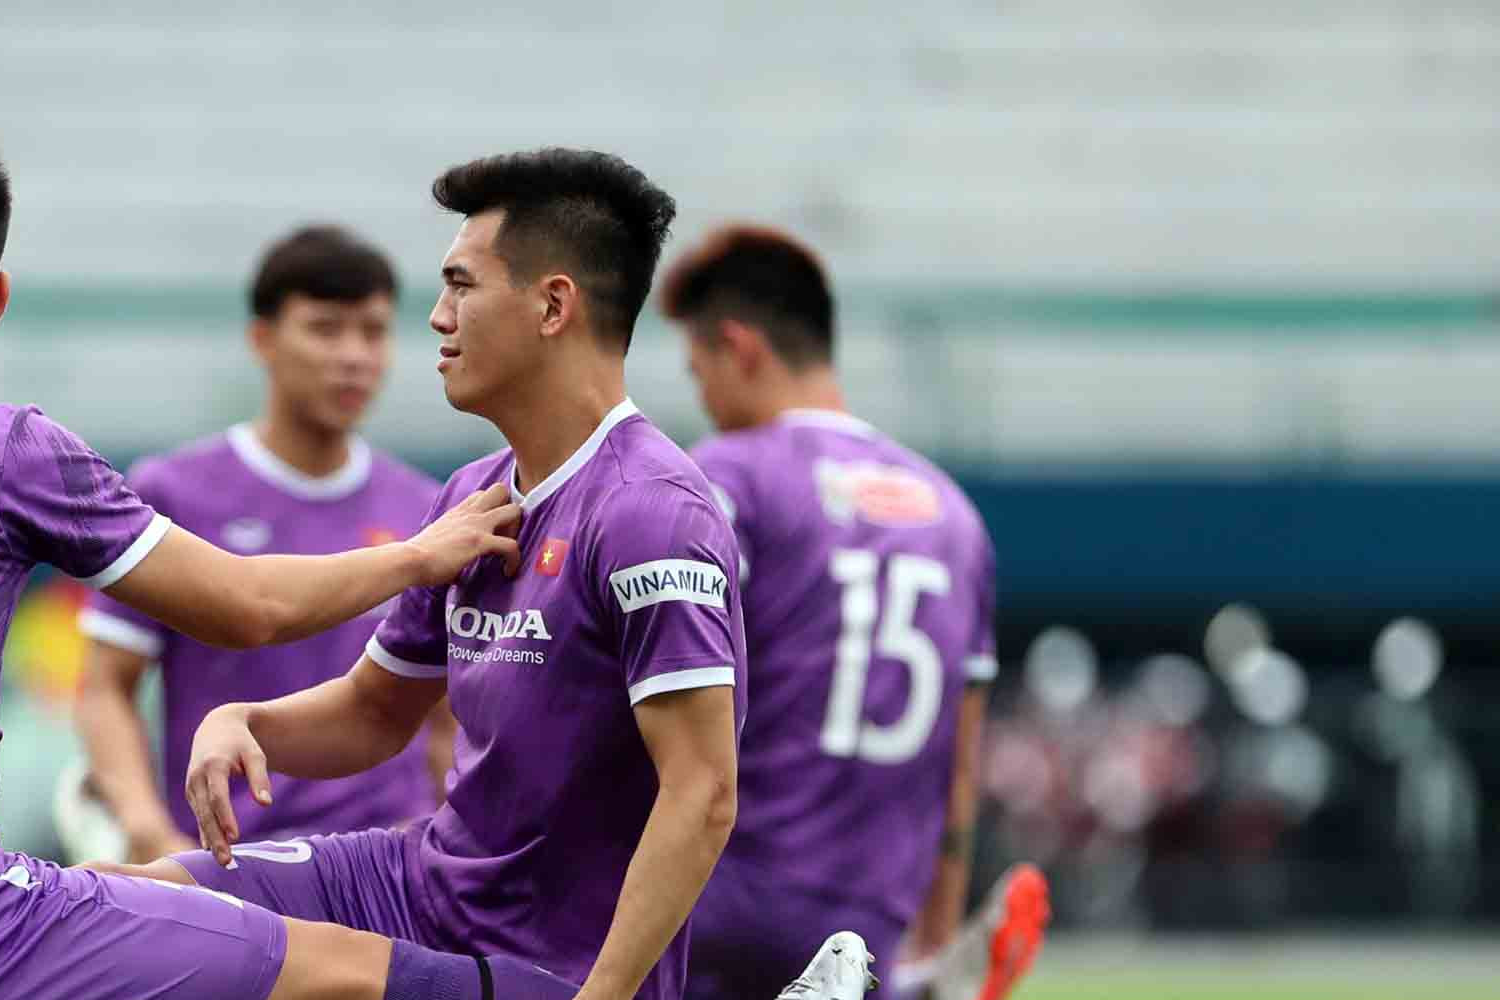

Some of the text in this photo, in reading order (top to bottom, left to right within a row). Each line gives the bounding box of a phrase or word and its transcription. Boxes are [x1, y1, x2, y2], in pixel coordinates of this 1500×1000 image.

[616, 569, 723, 601] VINAMILK
[493, 647, 545, 665] Dreams
[819, 549, 951, 765] 15
